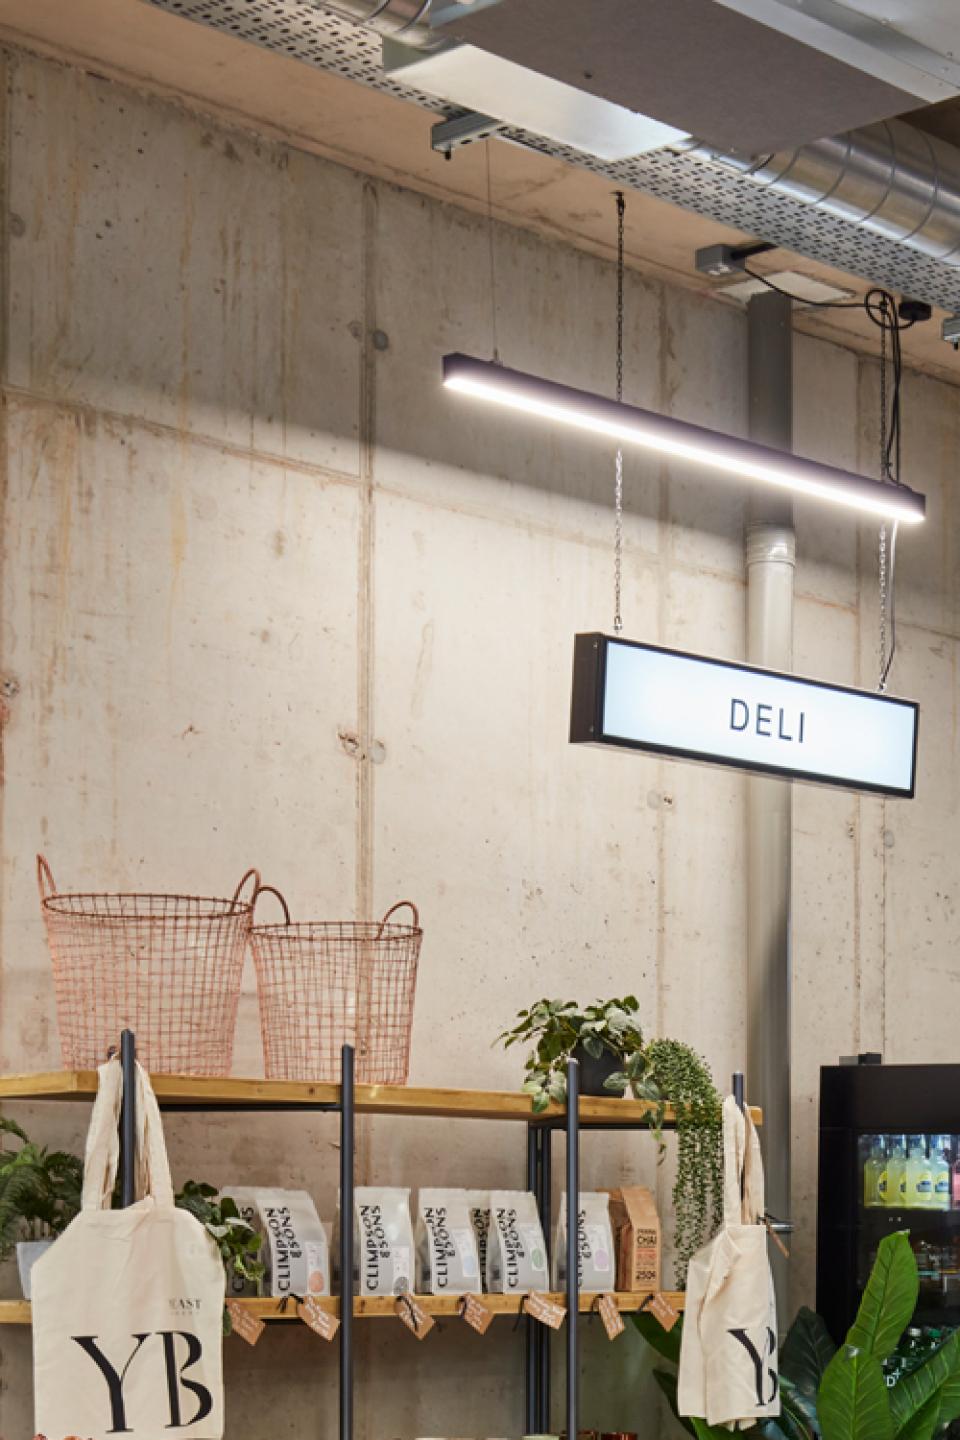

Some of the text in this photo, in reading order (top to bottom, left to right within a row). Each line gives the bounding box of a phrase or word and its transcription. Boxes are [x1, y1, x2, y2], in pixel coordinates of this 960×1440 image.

[730, 698, 805, 743] DELI
[264, 1207, 291, 1291] CLIMPSON
[359, 1205, 379, 1291] CLIMPSON
[70, 1330, 213, 1434] YB
